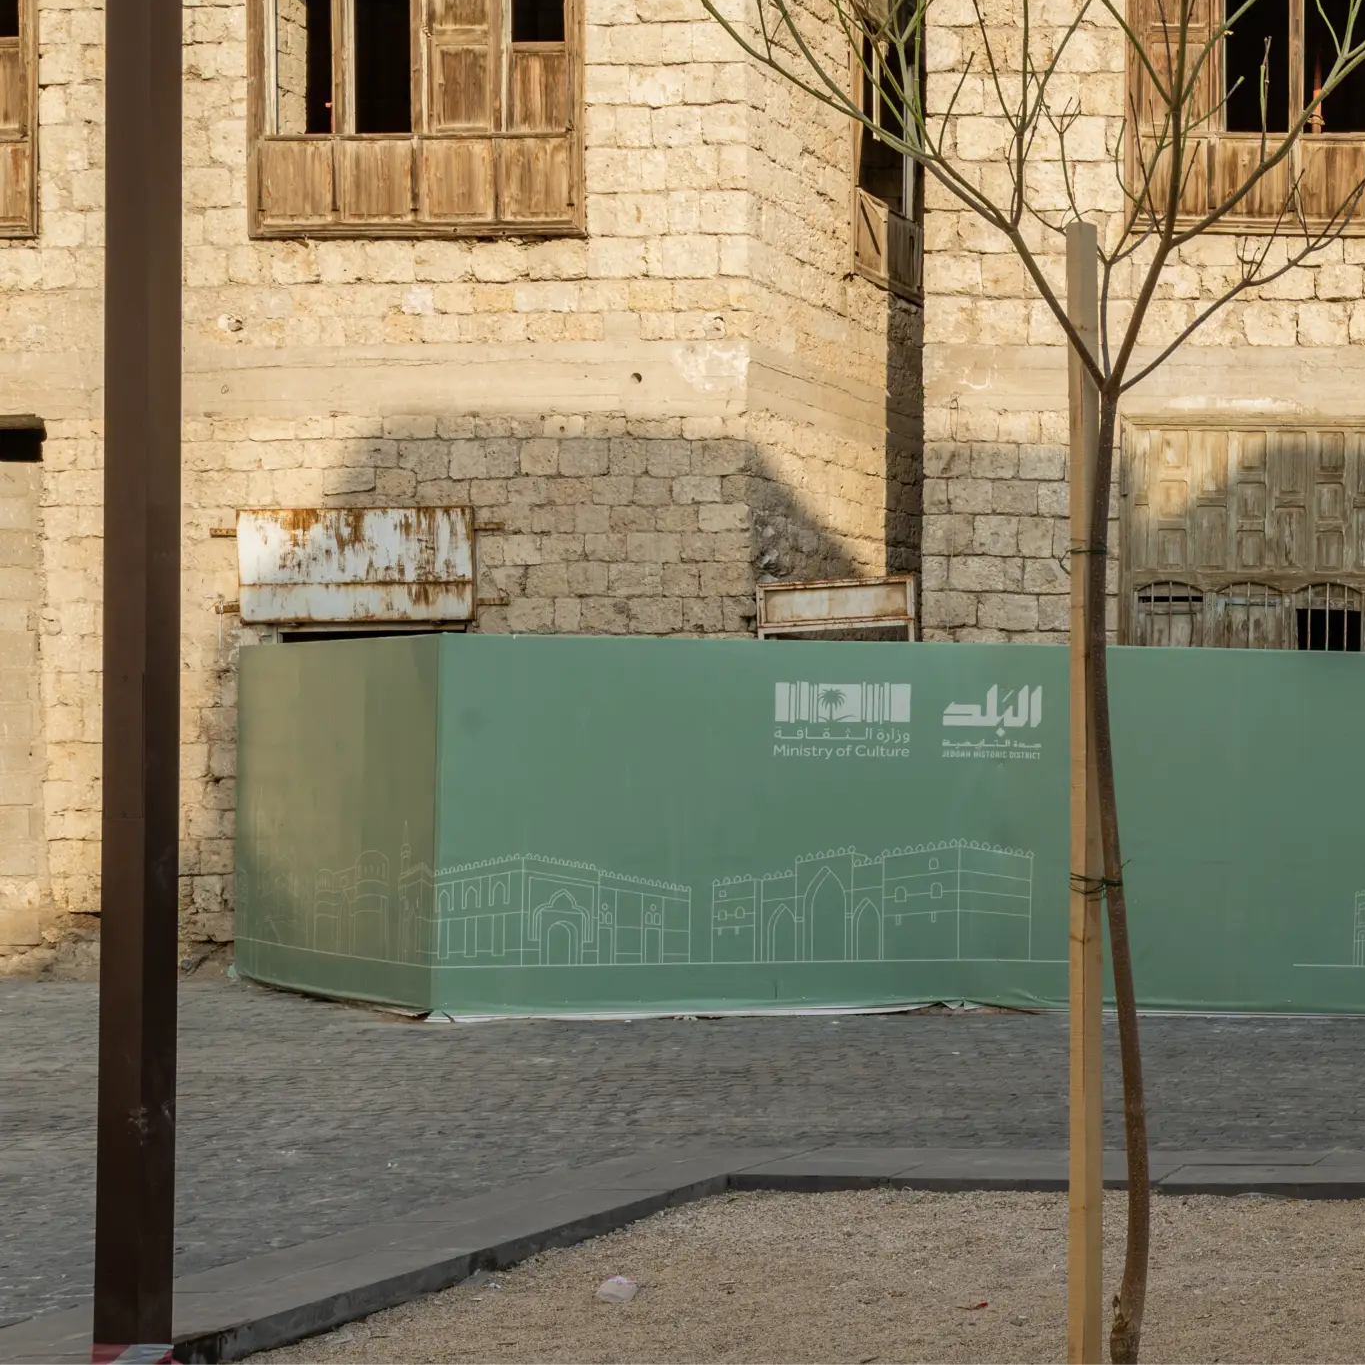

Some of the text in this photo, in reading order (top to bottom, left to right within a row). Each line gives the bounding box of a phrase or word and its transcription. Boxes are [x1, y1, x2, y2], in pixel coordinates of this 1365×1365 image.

[774, 726, 910, 743] وزارة الثقافة
[773, 744, 910, 760] Ministry of Culture
[942, 750, 1041, 760] JEDDAH HISTORIC DISTRICT
